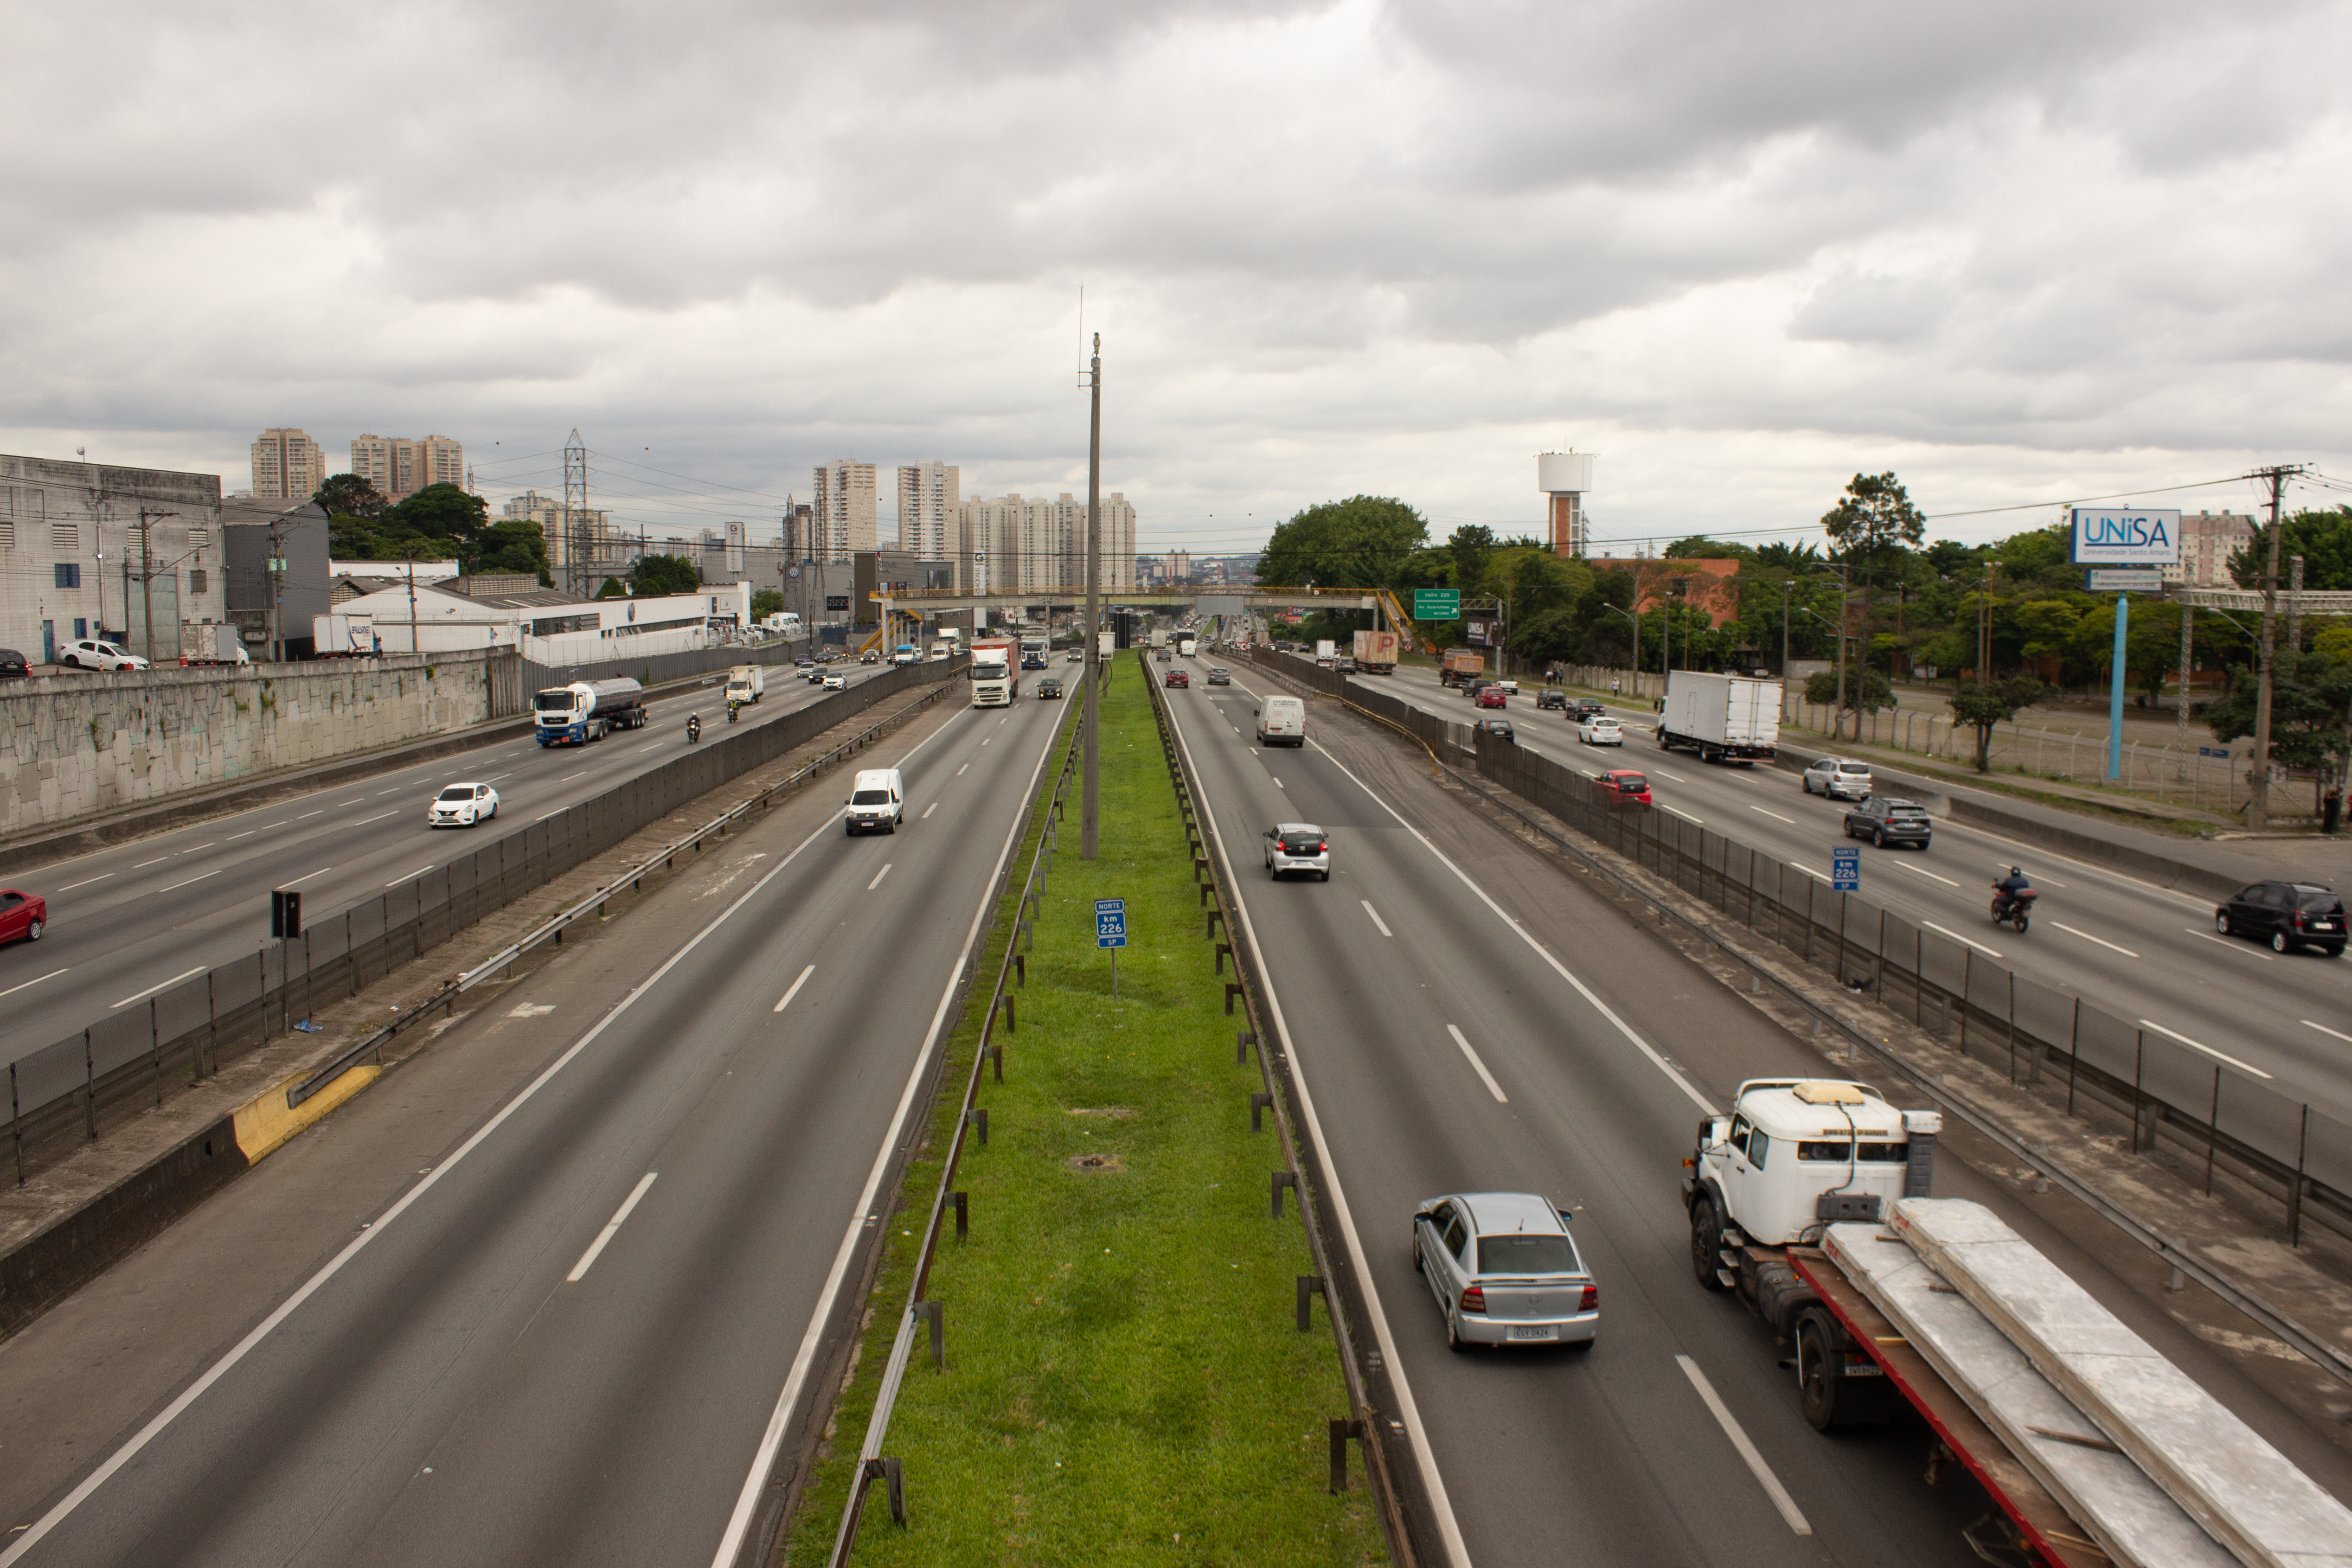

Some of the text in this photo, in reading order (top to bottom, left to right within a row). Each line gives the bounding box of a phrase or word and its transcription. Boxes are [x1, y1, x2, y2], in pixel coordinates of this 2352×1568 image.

[1468, 622, 1484, 634] UNISA
[1835, 869, 1857, 878] 226
[1101, 924, 1122, 934] 226
